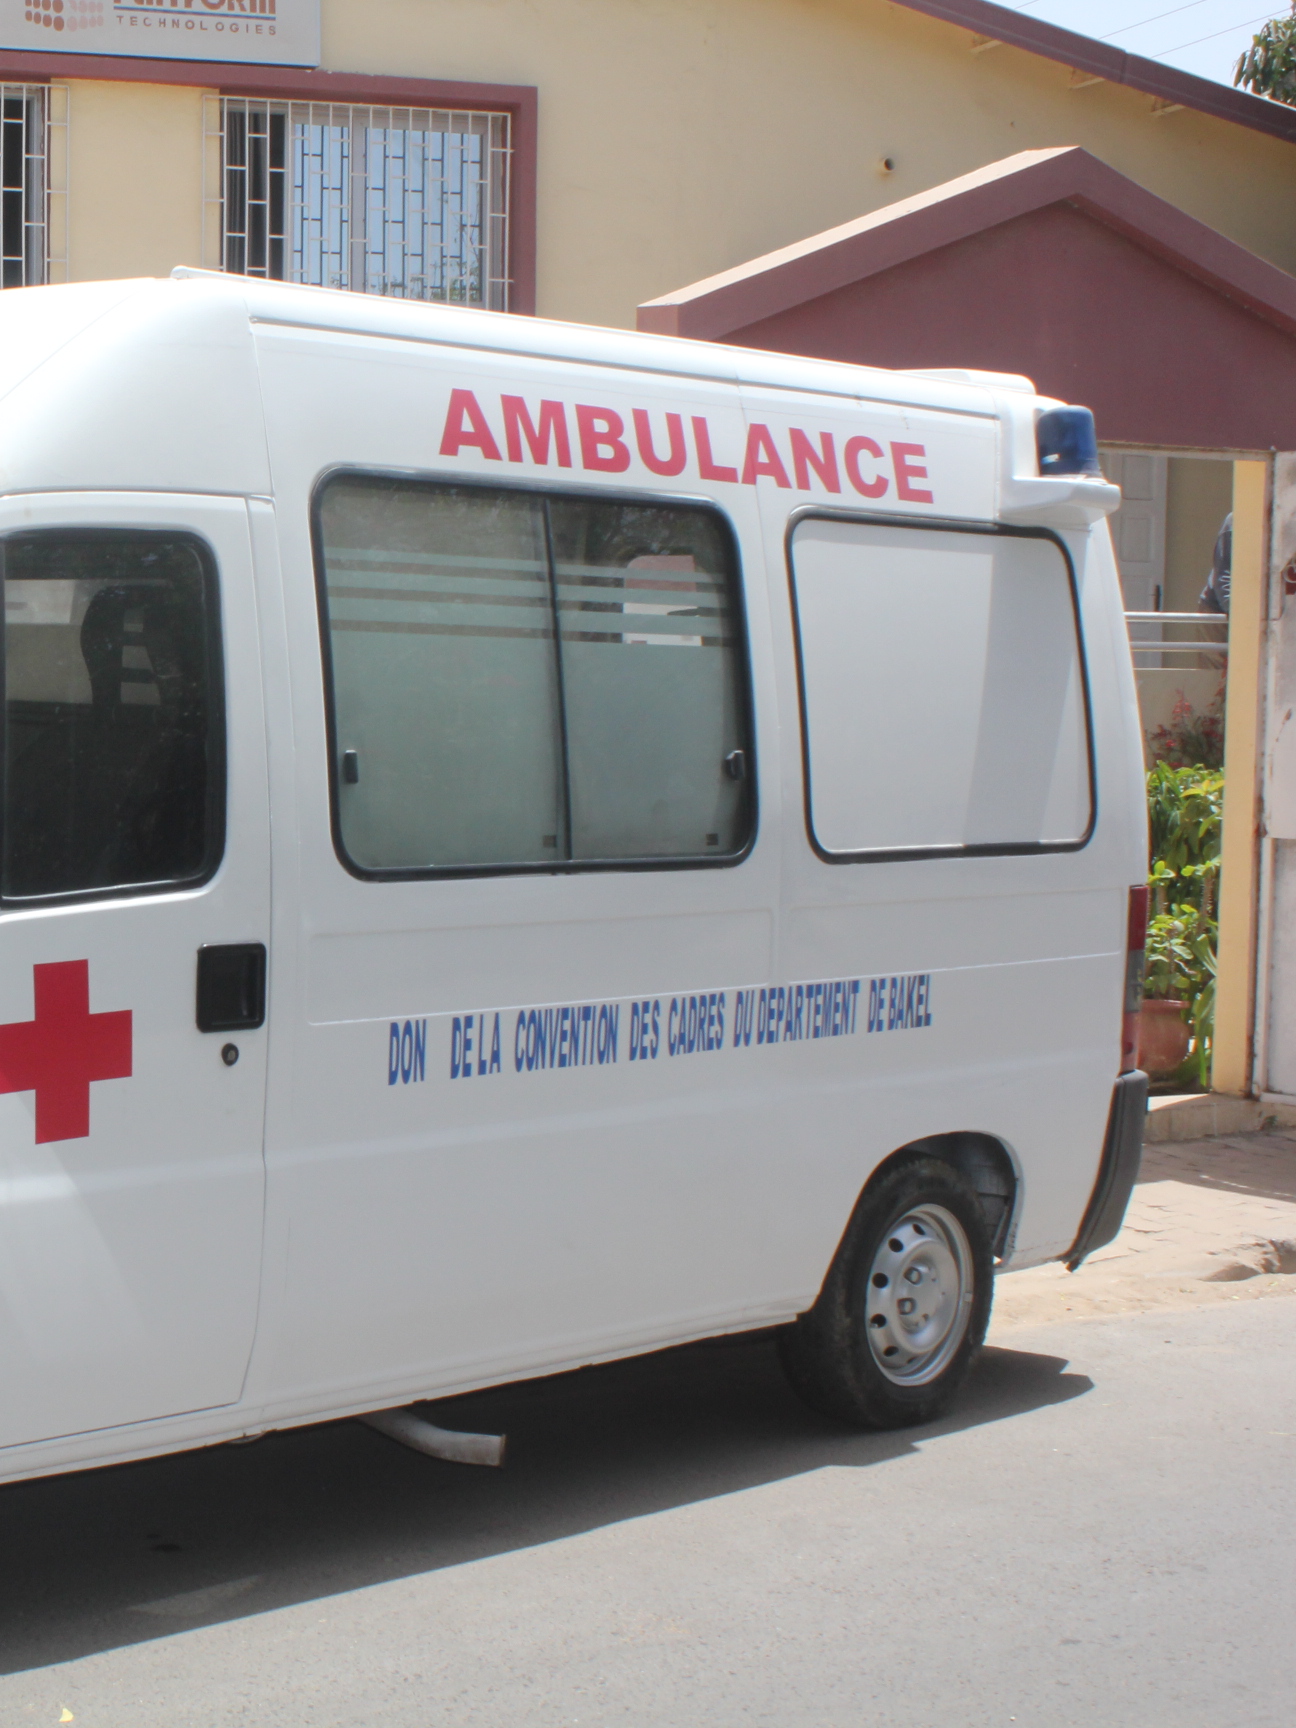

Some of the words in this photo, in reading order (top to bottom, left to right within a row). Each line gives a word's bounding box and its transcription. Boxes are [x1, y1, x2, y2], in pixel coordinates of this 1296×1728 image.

[116, 15, 277, 36] TECHNOLOGIES
[439, 388, 934, 504] AMBULANCE
[388, 1018, 427, 1086] DON
[450, 1015, 474, 1079] DE
[477, 1012, 501, 1076] LA
[514, 1004, 620, 1073] CONVENTION
[628, 999, 660, 1061] DES
[668, 992, 725, 1057] CADRES
[733, 989, 755, 1048] DU
[756, 979, 860, 1045] DEPARTEMENT
[866, 977, 887, 1033] DE
[887, 974, 932, 1031] BAKEL
